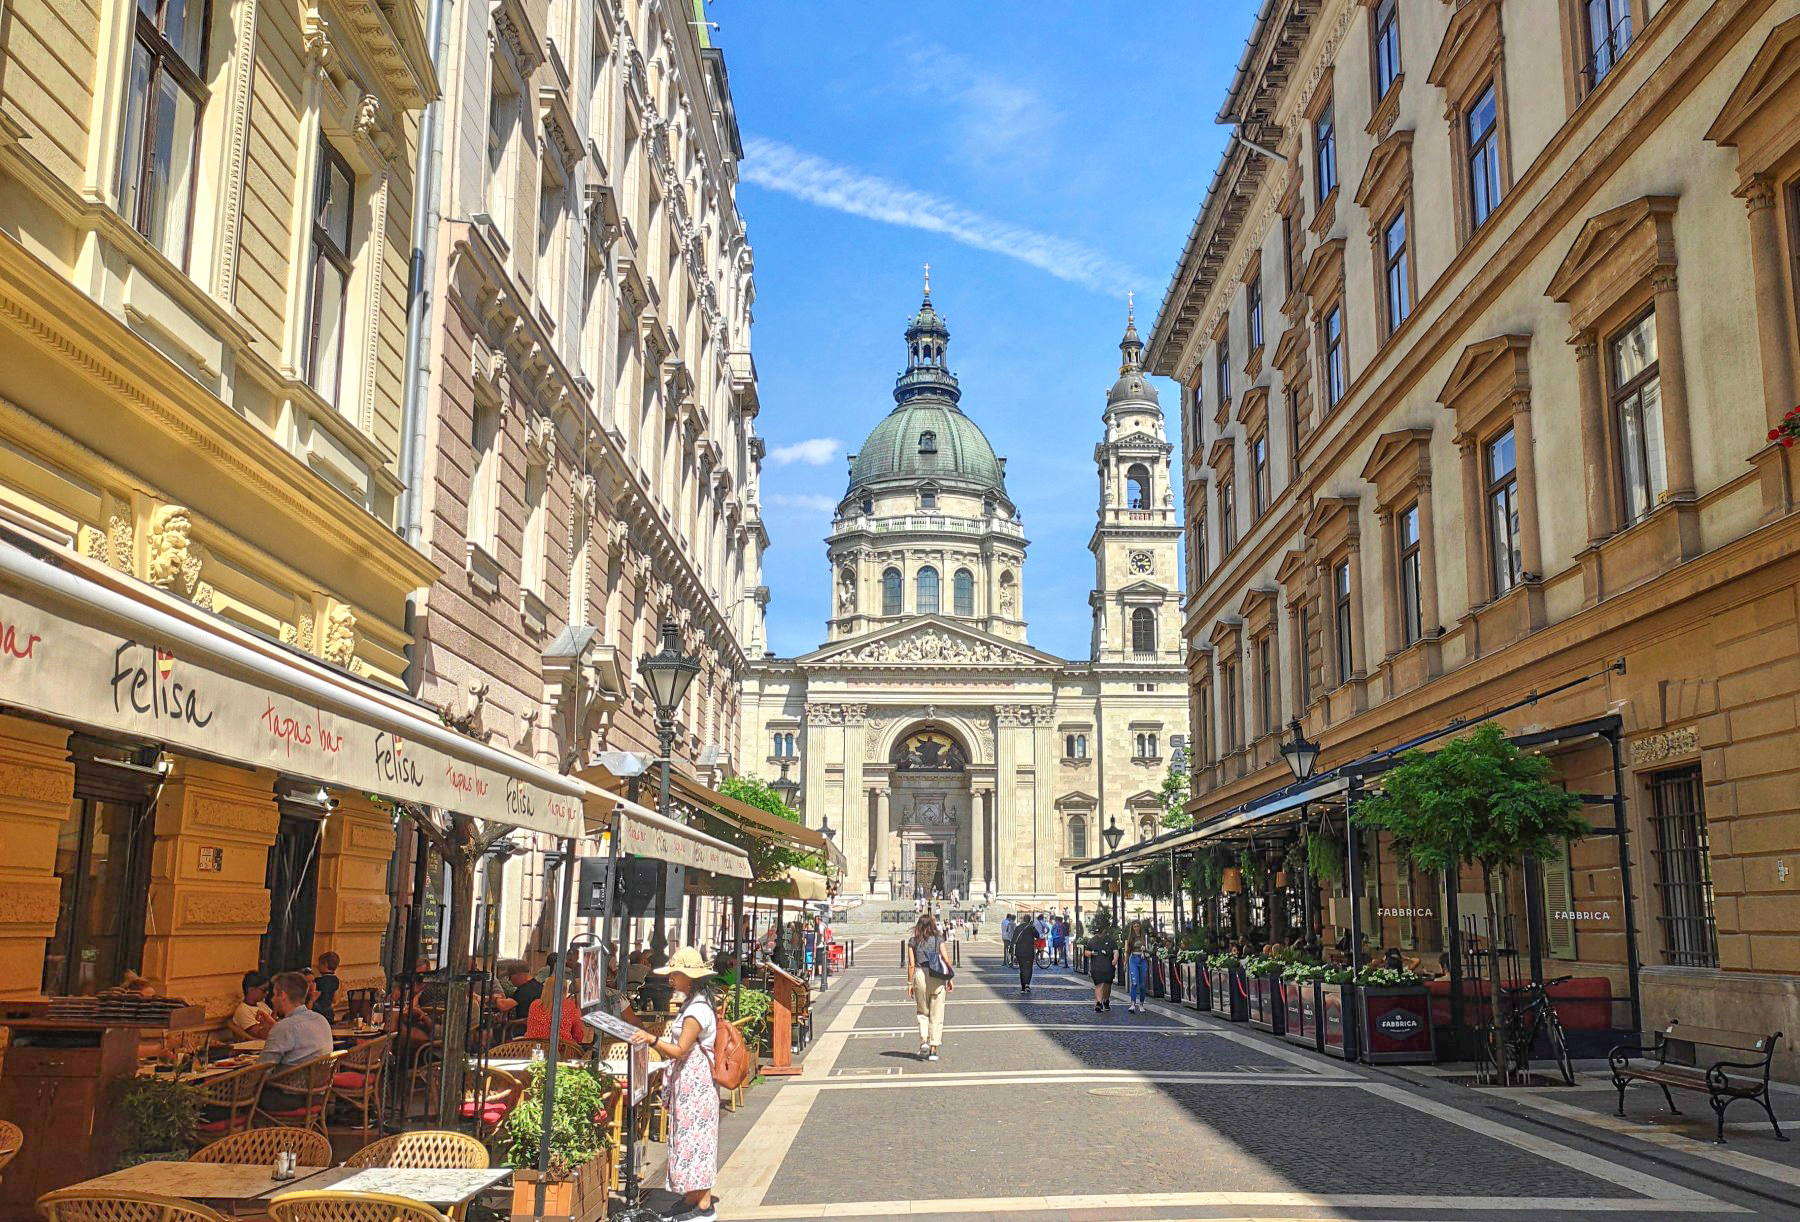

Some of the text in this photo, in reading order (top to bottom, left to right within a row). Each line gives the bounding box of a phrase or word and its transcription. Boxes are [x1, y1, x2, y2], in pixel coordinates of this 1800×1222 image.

[0, 622, 41, 659] ar
[111, 639, 213, 728] Felisa
[261, 696, 312, 758] tapas
[317, 704, 343, 753] bar
[375, 732, 424, 788] Felisa
[446, 759, 472, 802] tapas
[506, 776, 535, 817] Felisa
[1377, 908, 1433, 917] FABBRICA
[1554, 911, 1611, 920] FABBRICA
[1381, 1020, 1418, 1028] FABBRICA
